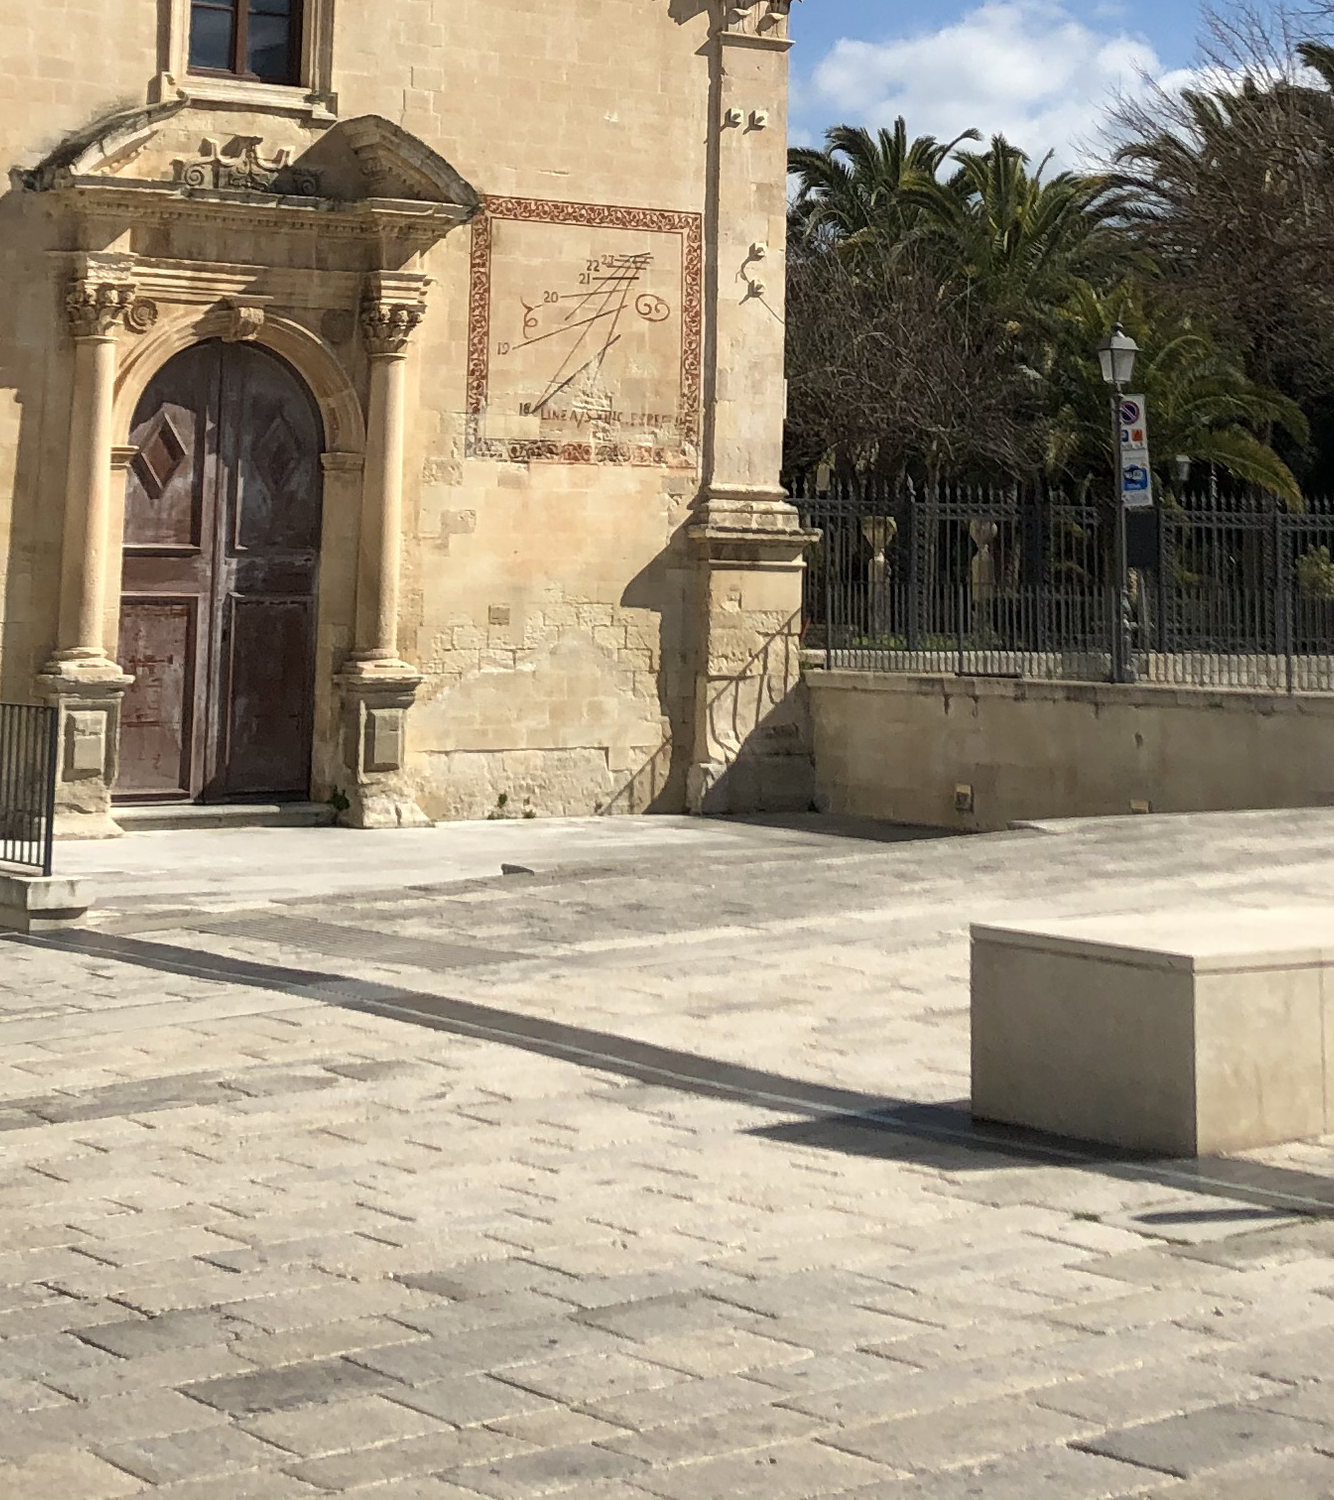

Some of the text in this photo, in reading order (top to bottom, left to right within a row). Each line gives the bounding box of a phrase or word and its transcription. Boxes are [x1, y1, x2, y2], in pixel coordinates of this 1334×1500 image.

[586, 259, 600, 272] 22
[601, 254, 615, 266] 23
[578, 272, 590, 285] 21
[543, 290, 559, 303] 20
[497, 341, 510, 355] 19
[519, 402, 531, 416] 18
